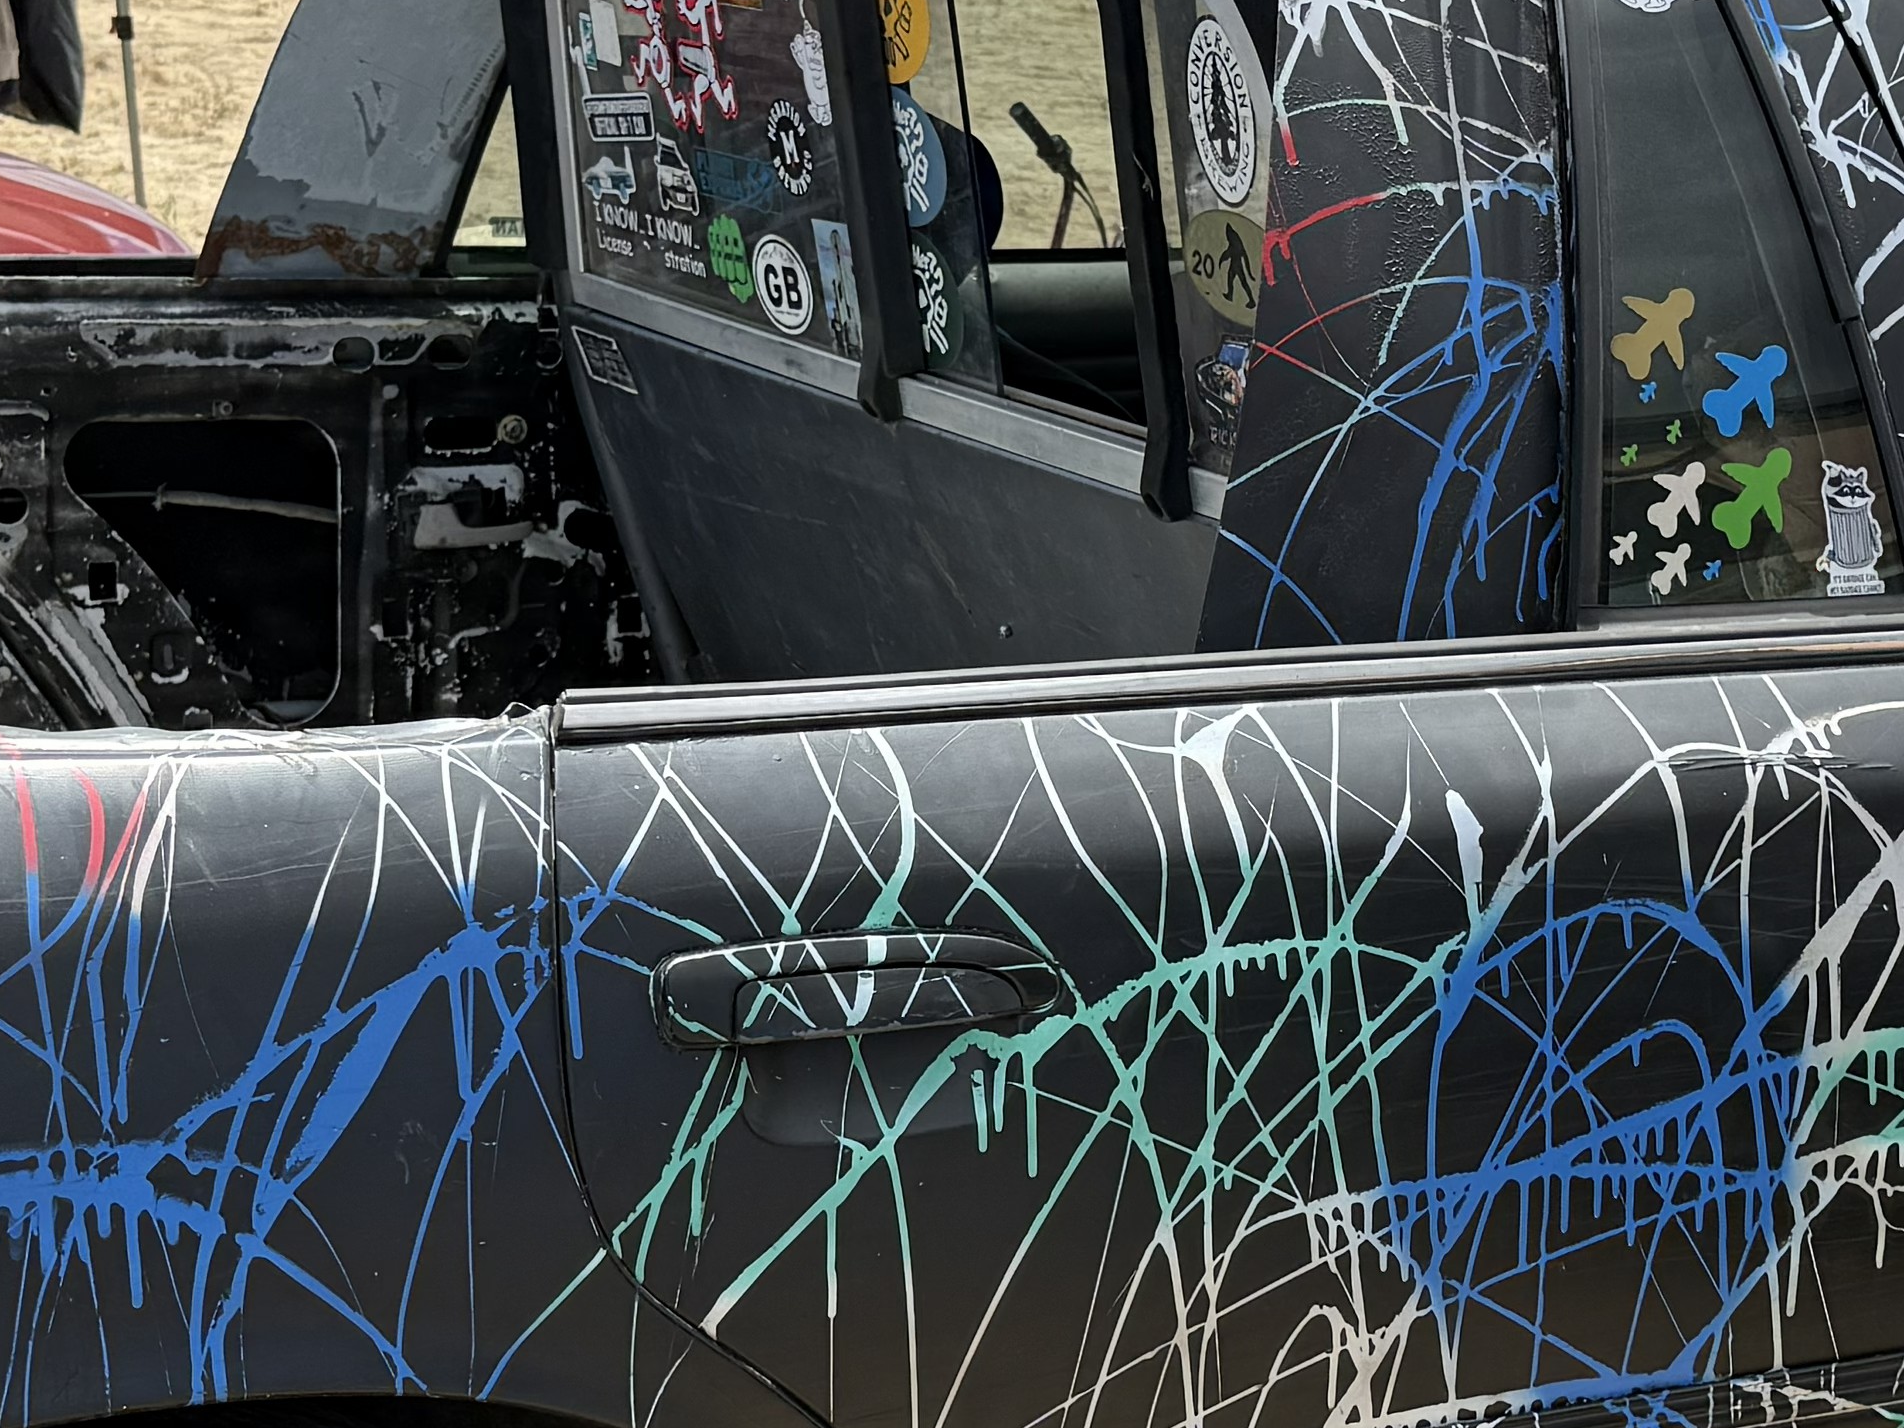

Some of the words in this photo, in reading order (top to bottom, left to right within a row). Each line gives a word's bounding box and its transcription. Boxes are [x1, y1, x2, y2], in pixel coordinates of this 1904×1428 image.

[1190, 29, 1249, 109] CONVERSION
[767, 100, 806, 142] MIGRATION
[779, 129, 800, 165] M
[1200, 137, 1251, 193] BREWING
[773, 155, 812, 196] BREWING
[593, 200, 602, 222] I
[645, 214, 655, 236] I
[1192, 249, 1215, 280] 20
[764, 263, 803, 311] GB
